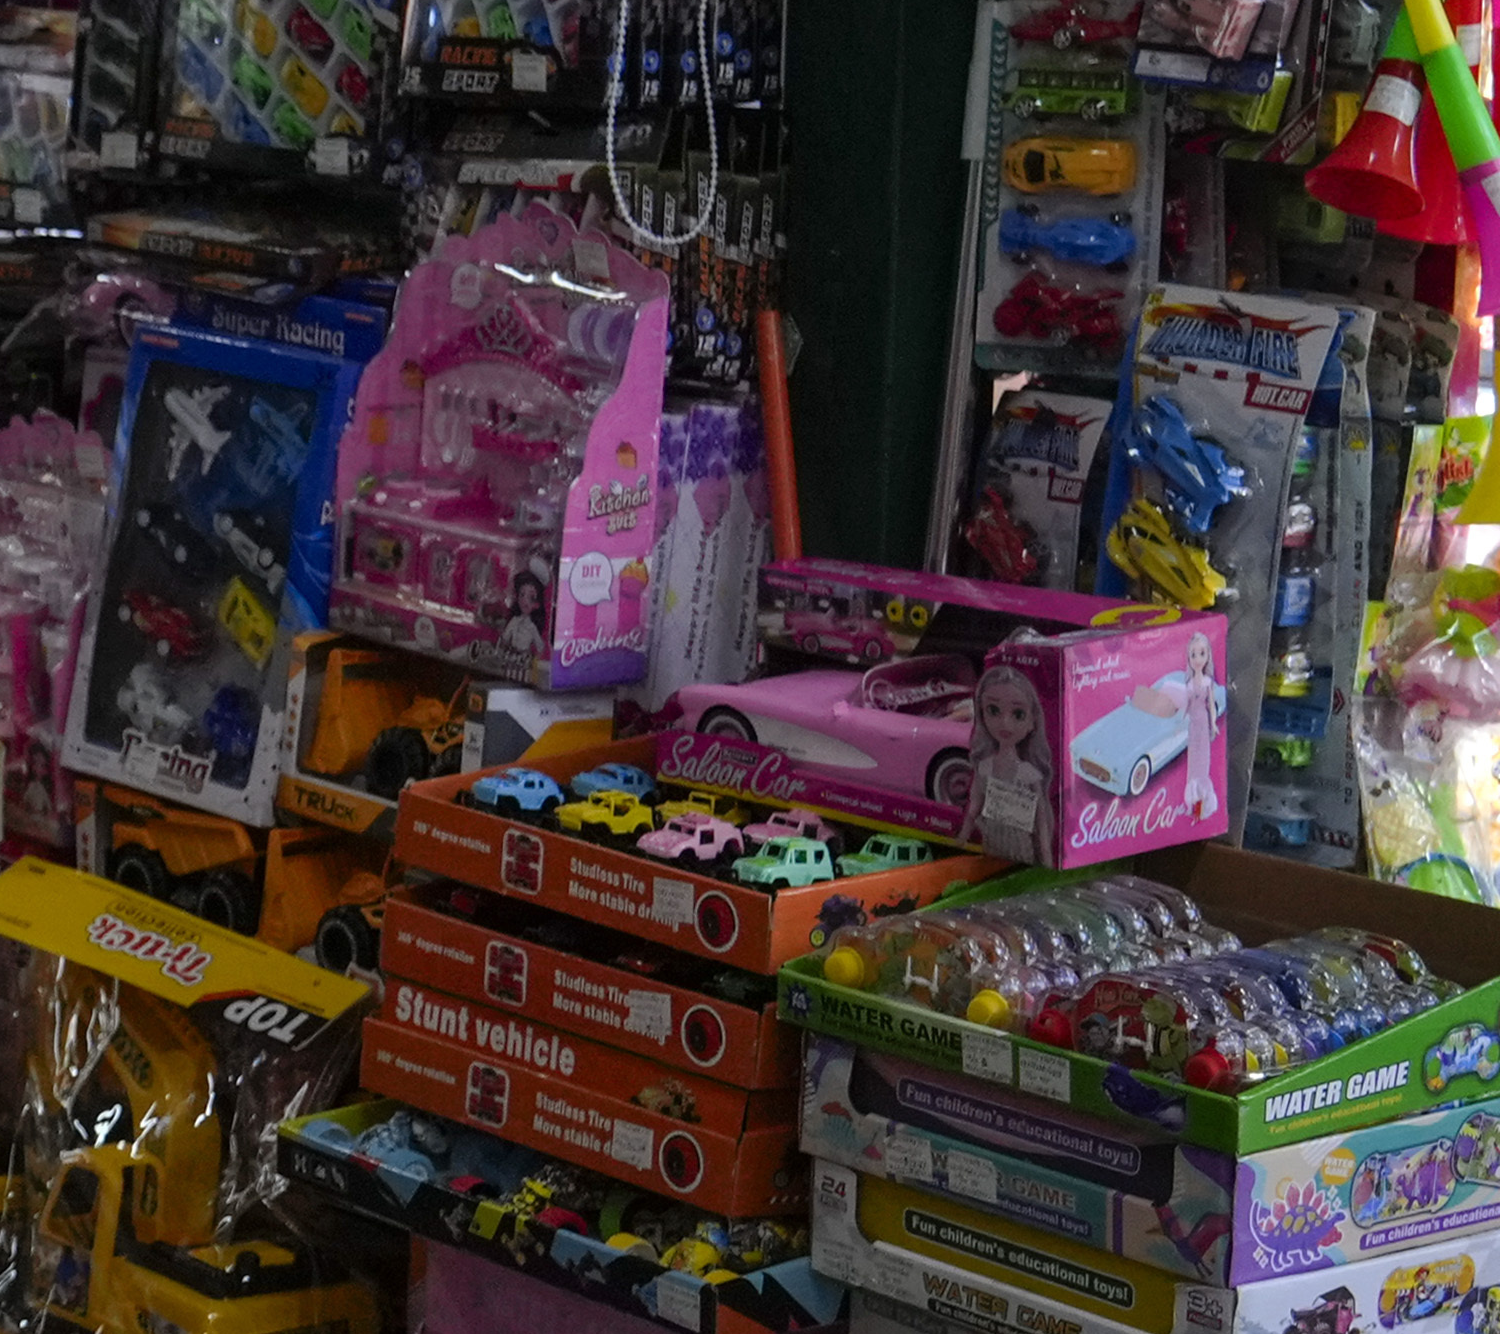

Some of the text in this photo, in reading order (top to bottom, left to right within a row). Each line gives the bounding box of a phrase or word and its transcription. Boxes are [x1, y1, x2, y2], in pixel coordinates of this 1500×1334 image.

[211, 303, 270, 337] Super
[581, 563, 602, 579] DIY
[560, 628, 649, 667] Cooking
[660, 735, 807, 801] Saloon Car
[1070, 796, 1140, 849] Saloon
[1142, 787, 1187, 835] Car
[569, 856, 646, 895] Studless Tire
[568, 880, 598, 903] More
[598, 888, 636, 916] stable
[86, 913, 215, 987] Truck
[552, 968, 604, 999] Studless
[222, 995, 310, 1044] TOP
[395, 985, 471, 1042] Stunt
[474, 1018, 577, 1077] vehicle
[552, 993, 621, 1029] More stable
[820, 994, 895, 1033] WATER
[900, 1018, 963, 1052] GAME
[535, 1091, 612, 1132] Studless Tire
[1263, 1061, 1411, 1125] WATER GAME
[533, 1112, 563, 1139] More
[563, 1124, 602, 1153] stable
[905, 1080, 1136, 1170] Fun children's educational toys!
[820, 1174, 847, 1198] 24
[1008, 1174, 1078, 1210] GAME
[1365, 1231, 1387, 1248] Fun
[1387, 1220, 1441, 1244] children's
[910, 1212, 1131, 1303] Fun children's educational toys!
[922, 1270, 1010, 1321] WATER
[1187, 1289, 1223, 1317] 3+
